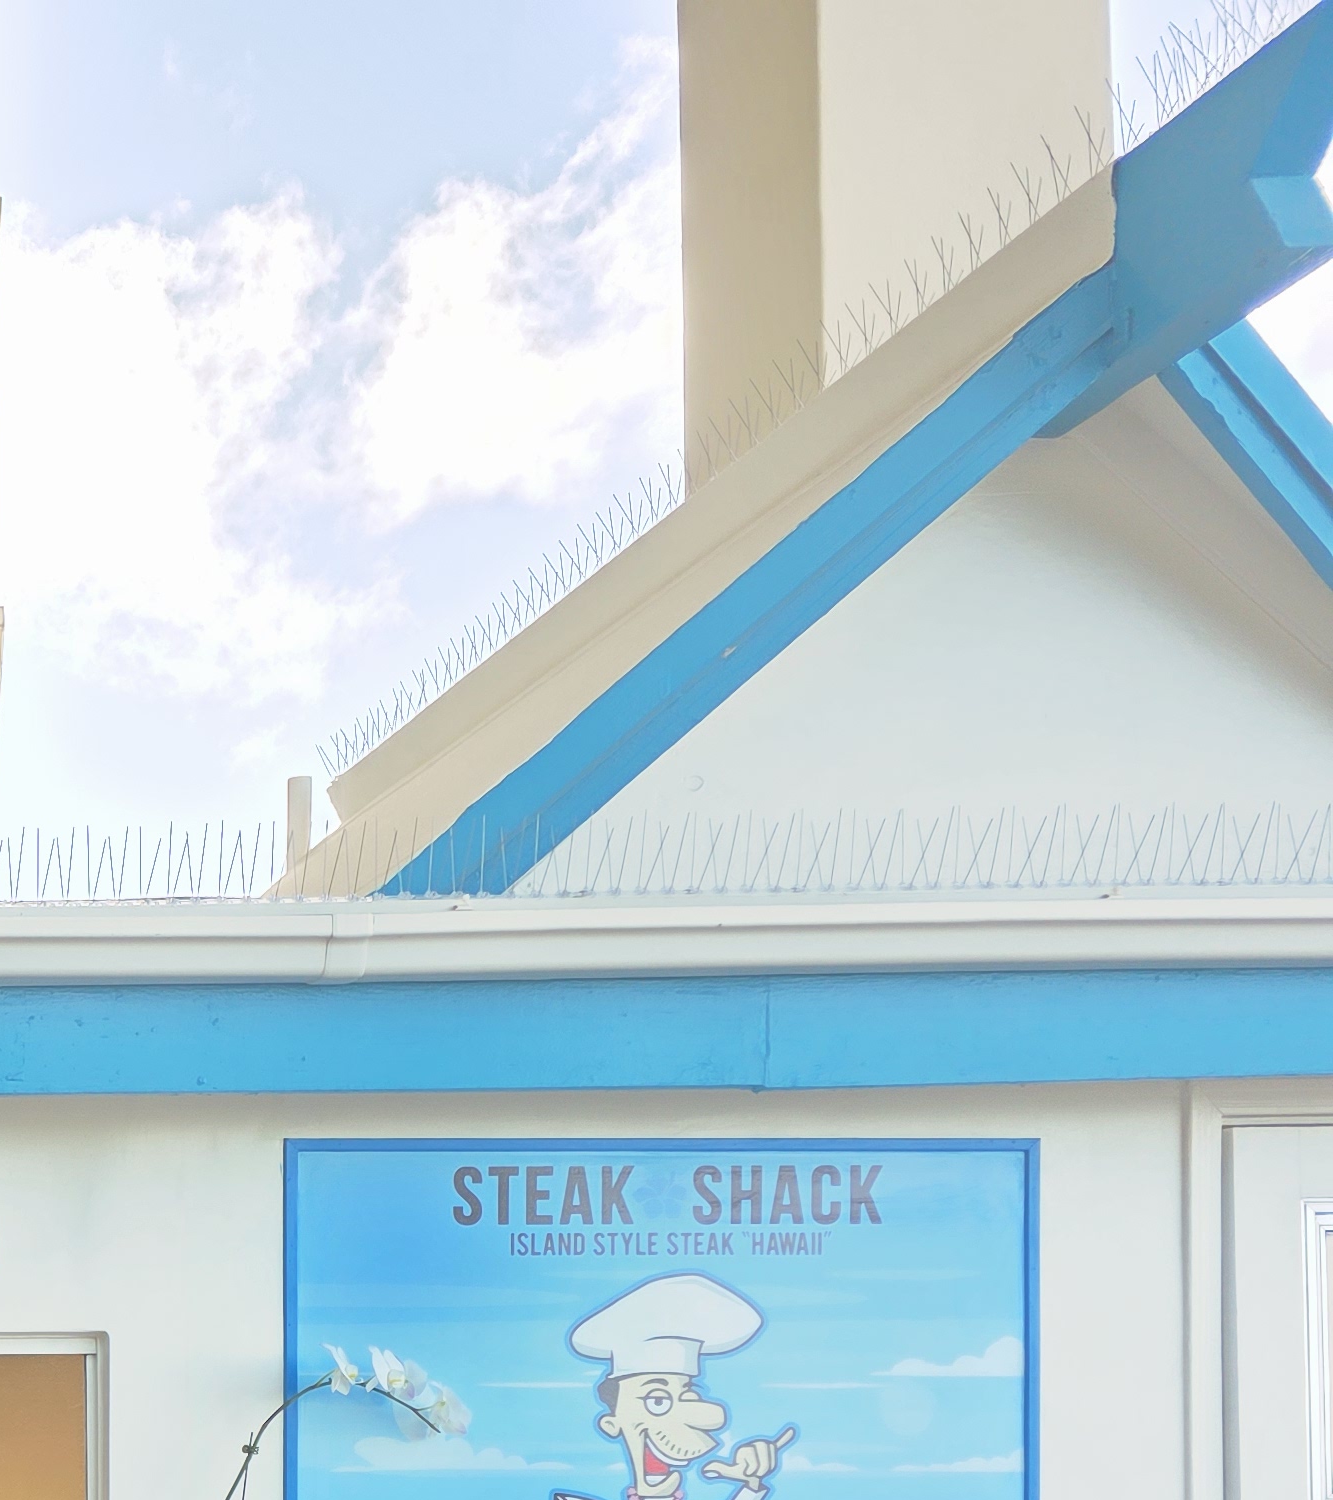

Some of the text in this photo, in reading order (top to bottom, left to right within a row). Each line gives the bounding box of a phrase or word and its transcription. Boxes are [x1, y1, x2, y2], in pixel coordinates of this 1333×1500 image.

[452, 1164, 883, 1225] STEAK SHACK
[509, 1232, 586, 1257] ISLAND
[592, 1232, 659, 1256] STYLE
[667, 1232, 734, 1256] STEAK
